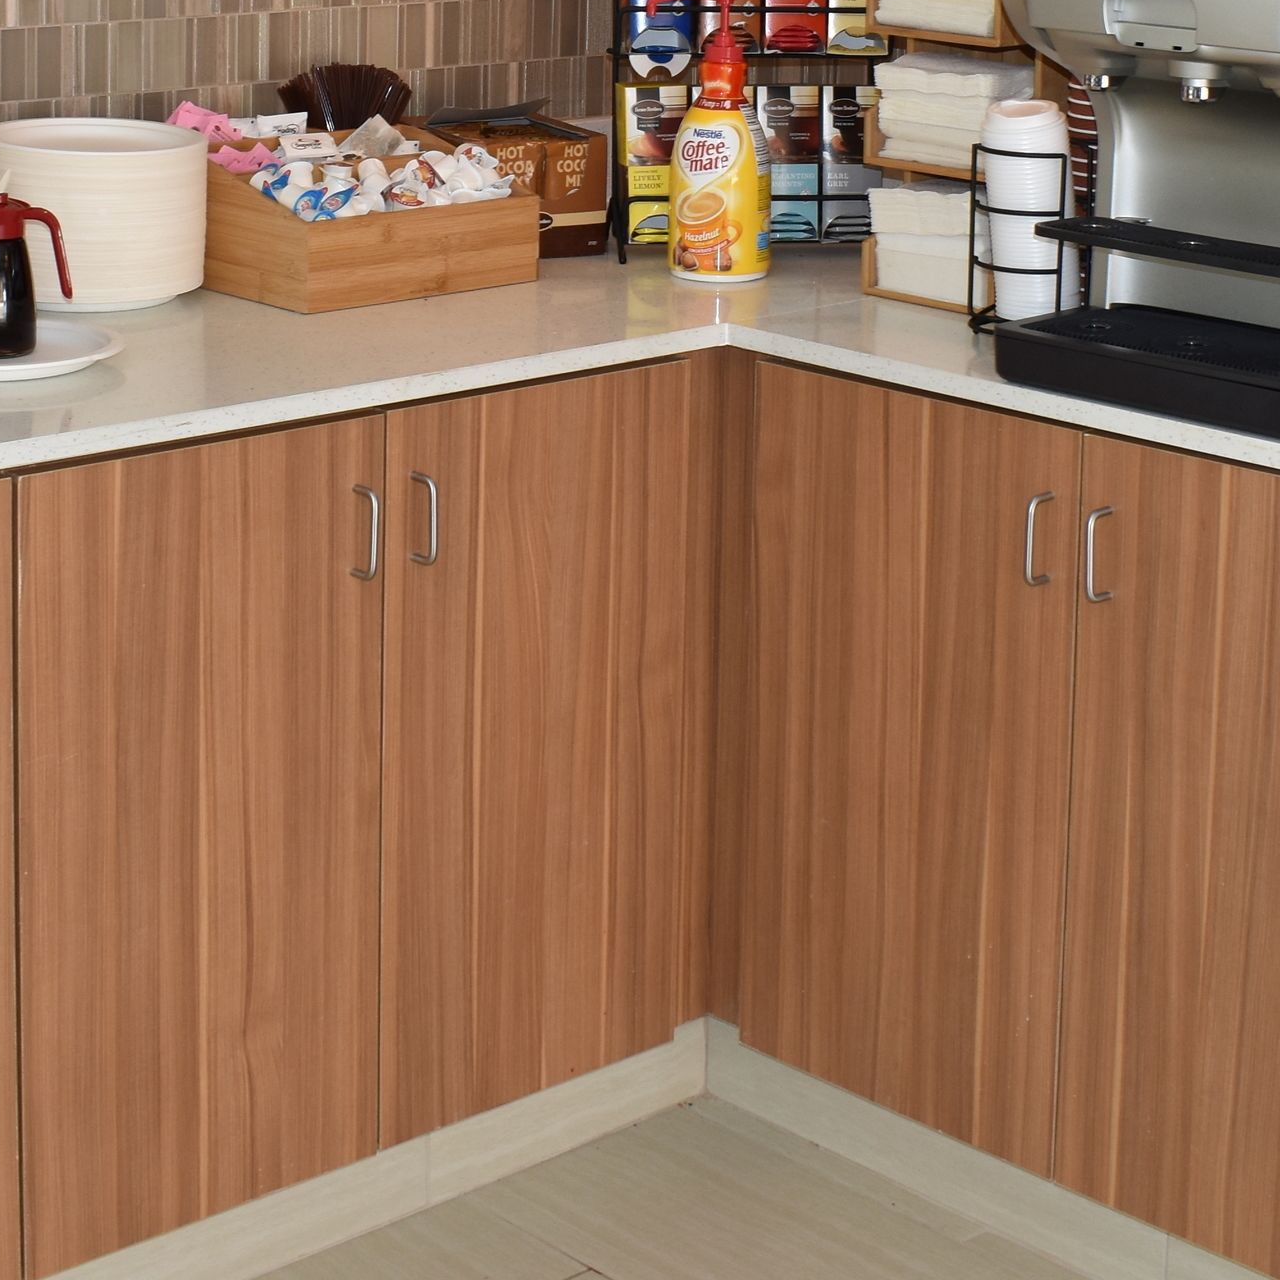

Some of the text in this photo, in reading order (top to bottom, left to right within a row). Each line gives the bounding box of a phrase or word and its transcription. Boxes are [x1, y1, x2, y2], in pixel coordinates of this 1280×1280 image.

[496, 145, 525, 160] HOT
[496, 160, 535, 175] OCOA
[689, 155, 729, 172] mate
[684, 227, 720, 241] Hazelnut
